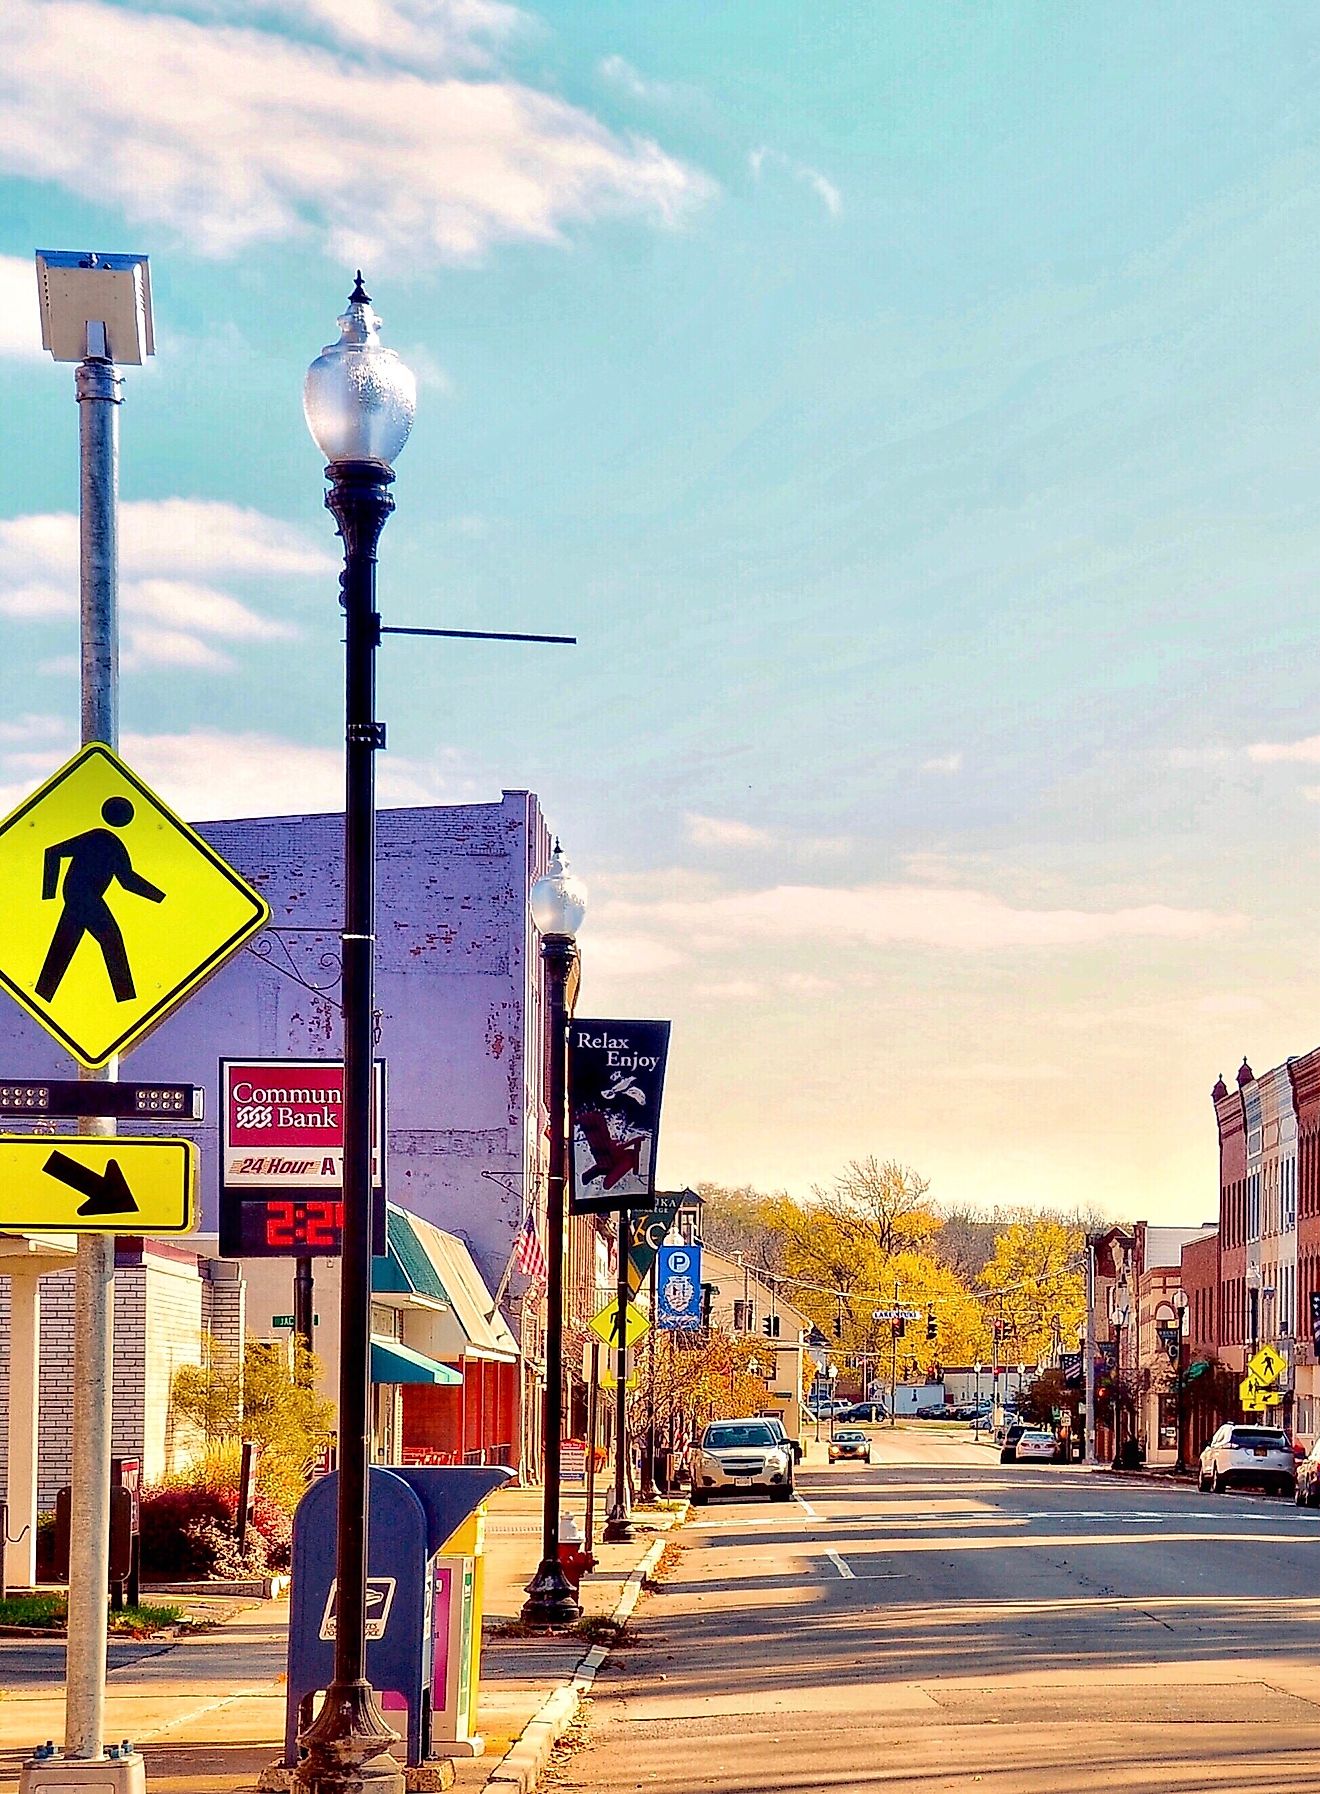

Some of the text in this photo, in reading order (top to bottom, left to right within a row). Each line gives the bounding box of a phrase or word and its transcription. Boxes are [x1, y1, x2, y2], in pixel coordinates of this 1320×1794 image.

[577, 1032, 629, 1049] Relax
[606, 1051, 660, 1072] Enjoy
[232, 1082, 343, 1104] Commun
[277, 1106, 338, 1128] Bank
[240, 1158, 264, 1174] 24
[267, 1158, 315, 1174] Hour
[267, 1201, 344, 1245] 2:2
[674, 1256, 685, 1269] P
